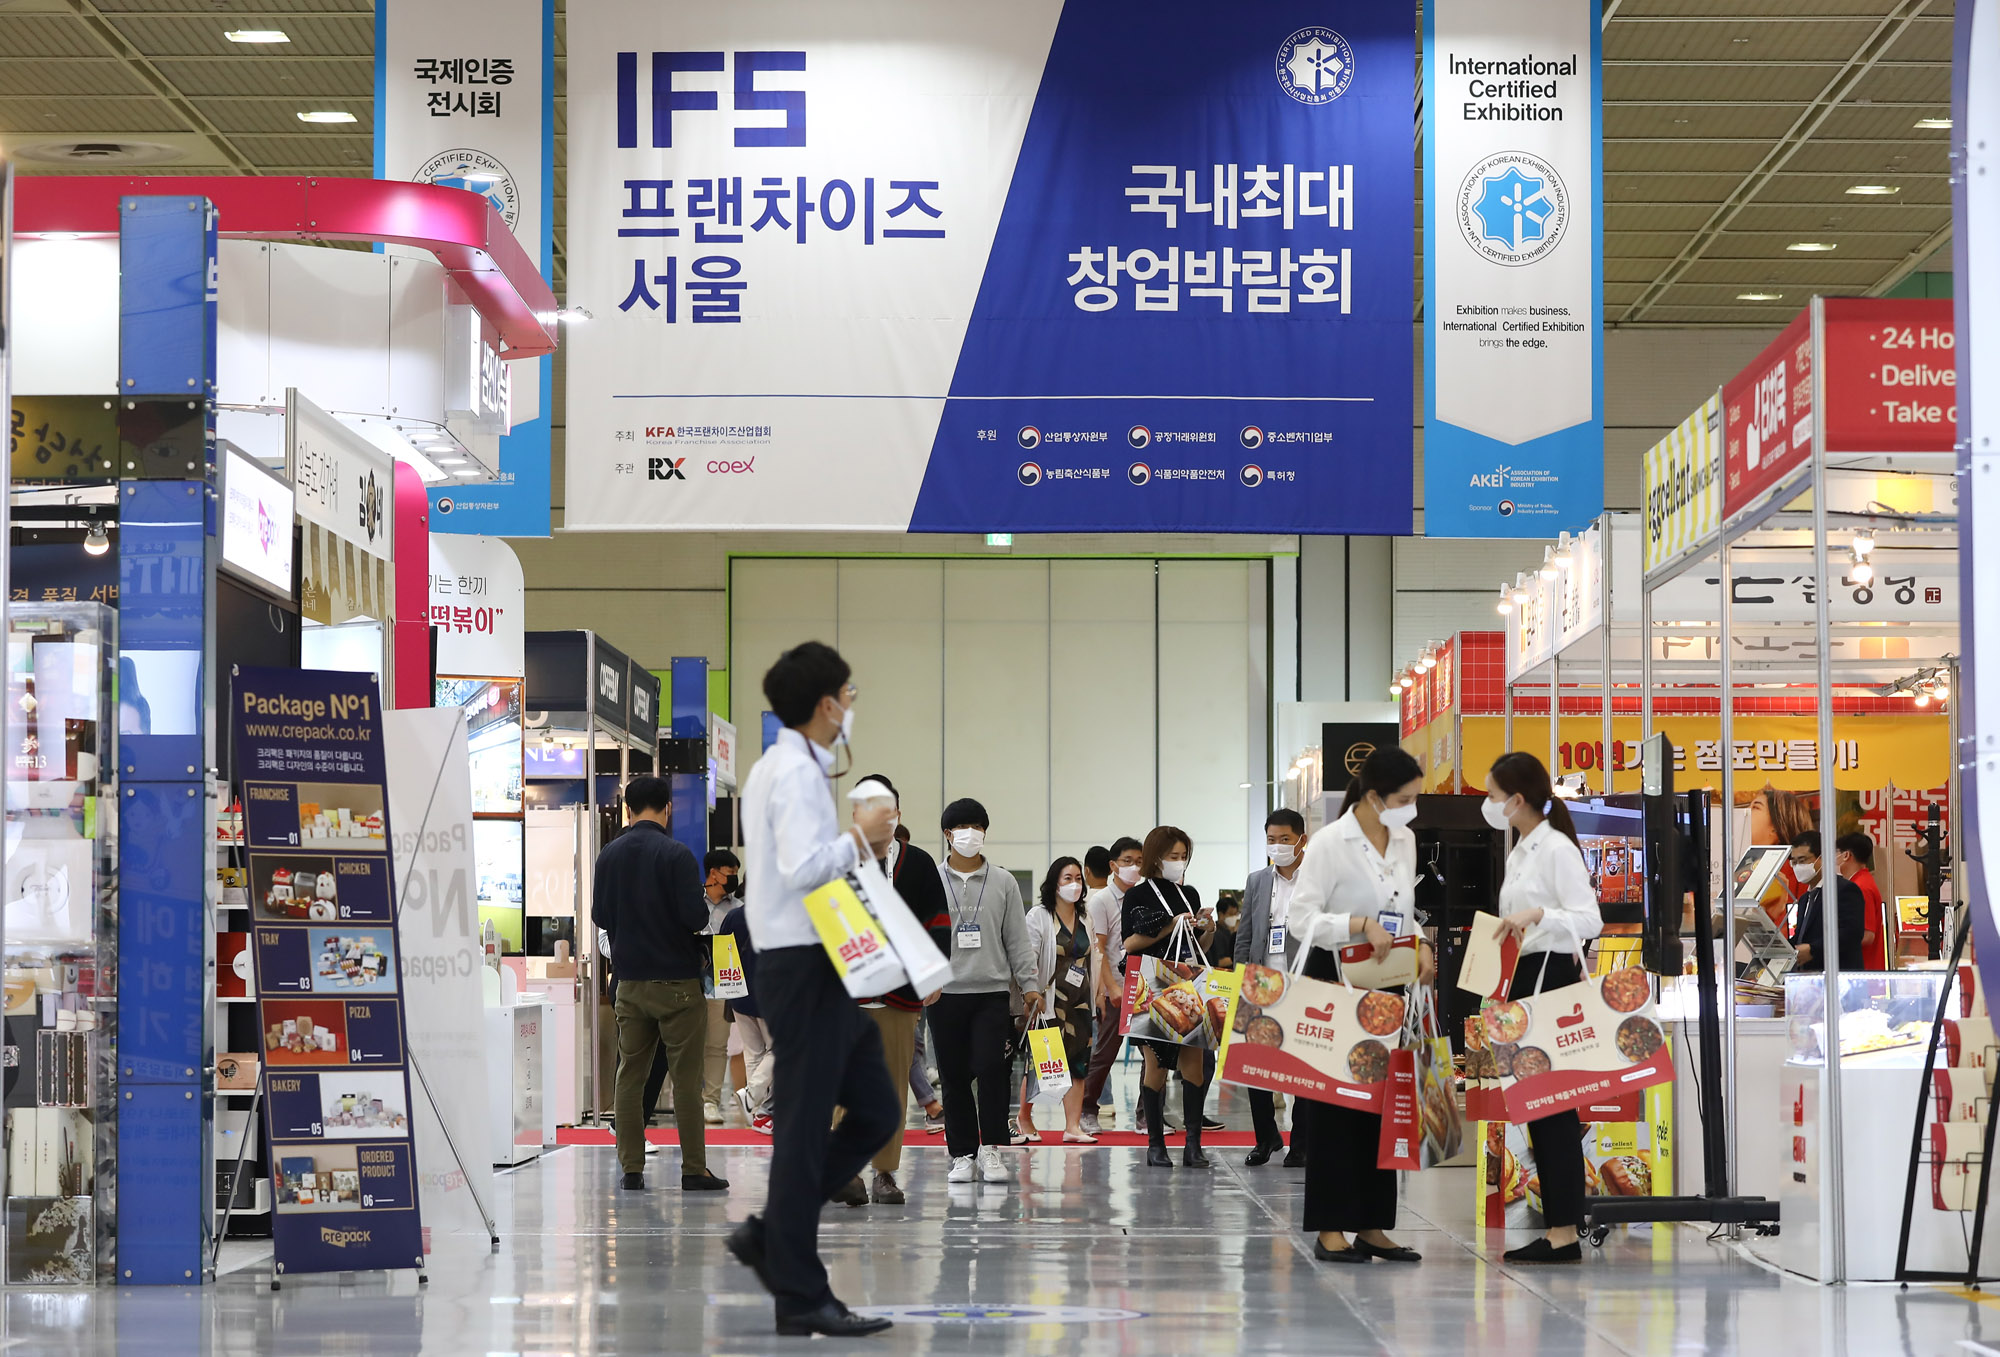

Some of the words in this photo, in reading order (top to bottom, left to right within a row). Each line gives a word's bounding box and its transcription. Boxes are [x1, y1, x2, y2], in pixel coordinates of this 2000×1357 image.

[1279, 30, 1312, 63] CERTIFIED
[1315, 29, 1352, 63] EXHIBITION
[1449, 53, 1577, 76] International
[414, 58, 515, 85] 국제인증
[1468, 79, 1557, 98] Certified
[426, 90, 501, 118] 전시회
[617, 50, 807, 149] IFS
[1463, 103, 1563, 121] Exhibition
[424, 153, 473, 177] CERTIFIED
[1124, 163, 1354, 231] 국내최대
[1461, 173, 1480, 227] ASSOCIATION
[1477, 164, 1487, 176] OF
[1487, 156, 1521, 169] KOREAN
[1522, 156, 1558, 188] EXHIBITION
[1554, 184, 1566, 229] INDUSTRY
[617, 176, 946, 245] 프랜차이즈
[1482, 244, 1521, 263] CERTIFIED
[1521, 230, 1559, 261] EXHIBITION
[1066, 246, 1352, 315] 창업박람회
[618, 256, 749, 324] 서울
[1456, 305, 1498, 315] Exhibition
[1501, 306, 1527, 315] makes
[1529, 305, 1571, 316] business.
[1443, 321, 1497, 331] International
[1502, 321, 1540, 332] Certified
[1542, 322, 1585, 332] Exhibition
[1479, 338, 1503, 348] brings
[1506, 338, 1519, 347] the
[1522, 338, 1548, 349] edge.
[1882, 327, 1915, 349] 24
[1920, 327, 1955, 349] Ho
[1882, 364, 1957, 387] Delive
[1882, 400, 1942, 423] Take
[615, 430, 635, 442] 주최
[645, 427, 675, 438] KFA
[677, 426, 772, 438] 한국프랜차이즈산업협회
[976, 429, 997, 441] 후원
[1044, 431, 1108, 443] 산업통상자원부
[1154, 431, 1217, 443] 공정거래위원회
[1266, 431, 1333, 443] 중소벤처기업부
[615, 463, 635, 474] 주관
[706, 456, 755, 474] coex
[1045, 468, 1111, 480] 농림축산식품부
[1154, 469, 1225, 480] 식품의약품안전처
[1266, 470, 1296, 482] 특허청
[458, 576, 488, 596] 한끼
[89, 585, 119, 604] 서비
[244, 692, 326, 721] Package
[246, 724, 371, 742] www.crepack.co.kr
[250, 787, 289, 801] FRANCHISE
[288, 832, 299, 845] 01
[338, 862, 371, 875] CHICKEN
[340, 905, 351, 917] 02
[260, 933, 280, 945] TRAY
[300, 977, 311, 990] 03
[350, 1007, 372, 1019] PIZZA
[1296, 1022, 1335, 1042] 터치쿡
[1555, 1026, 1596, 1049] 터치쿡
[351, 1049, 363, 1061] 04
[271, 1079, 301, 1092] BAKERY
[311, 1123, 322, 1135] 05
[1601, 1140, 1633, 1149] eggcellent
[361, 1151, 395, 1163] ORDERED
[362, 1165, 396, 1178] PRODUCT
[363, 1194, 374, 1207] 06
[322, 1229, 371, 1247] crepack
